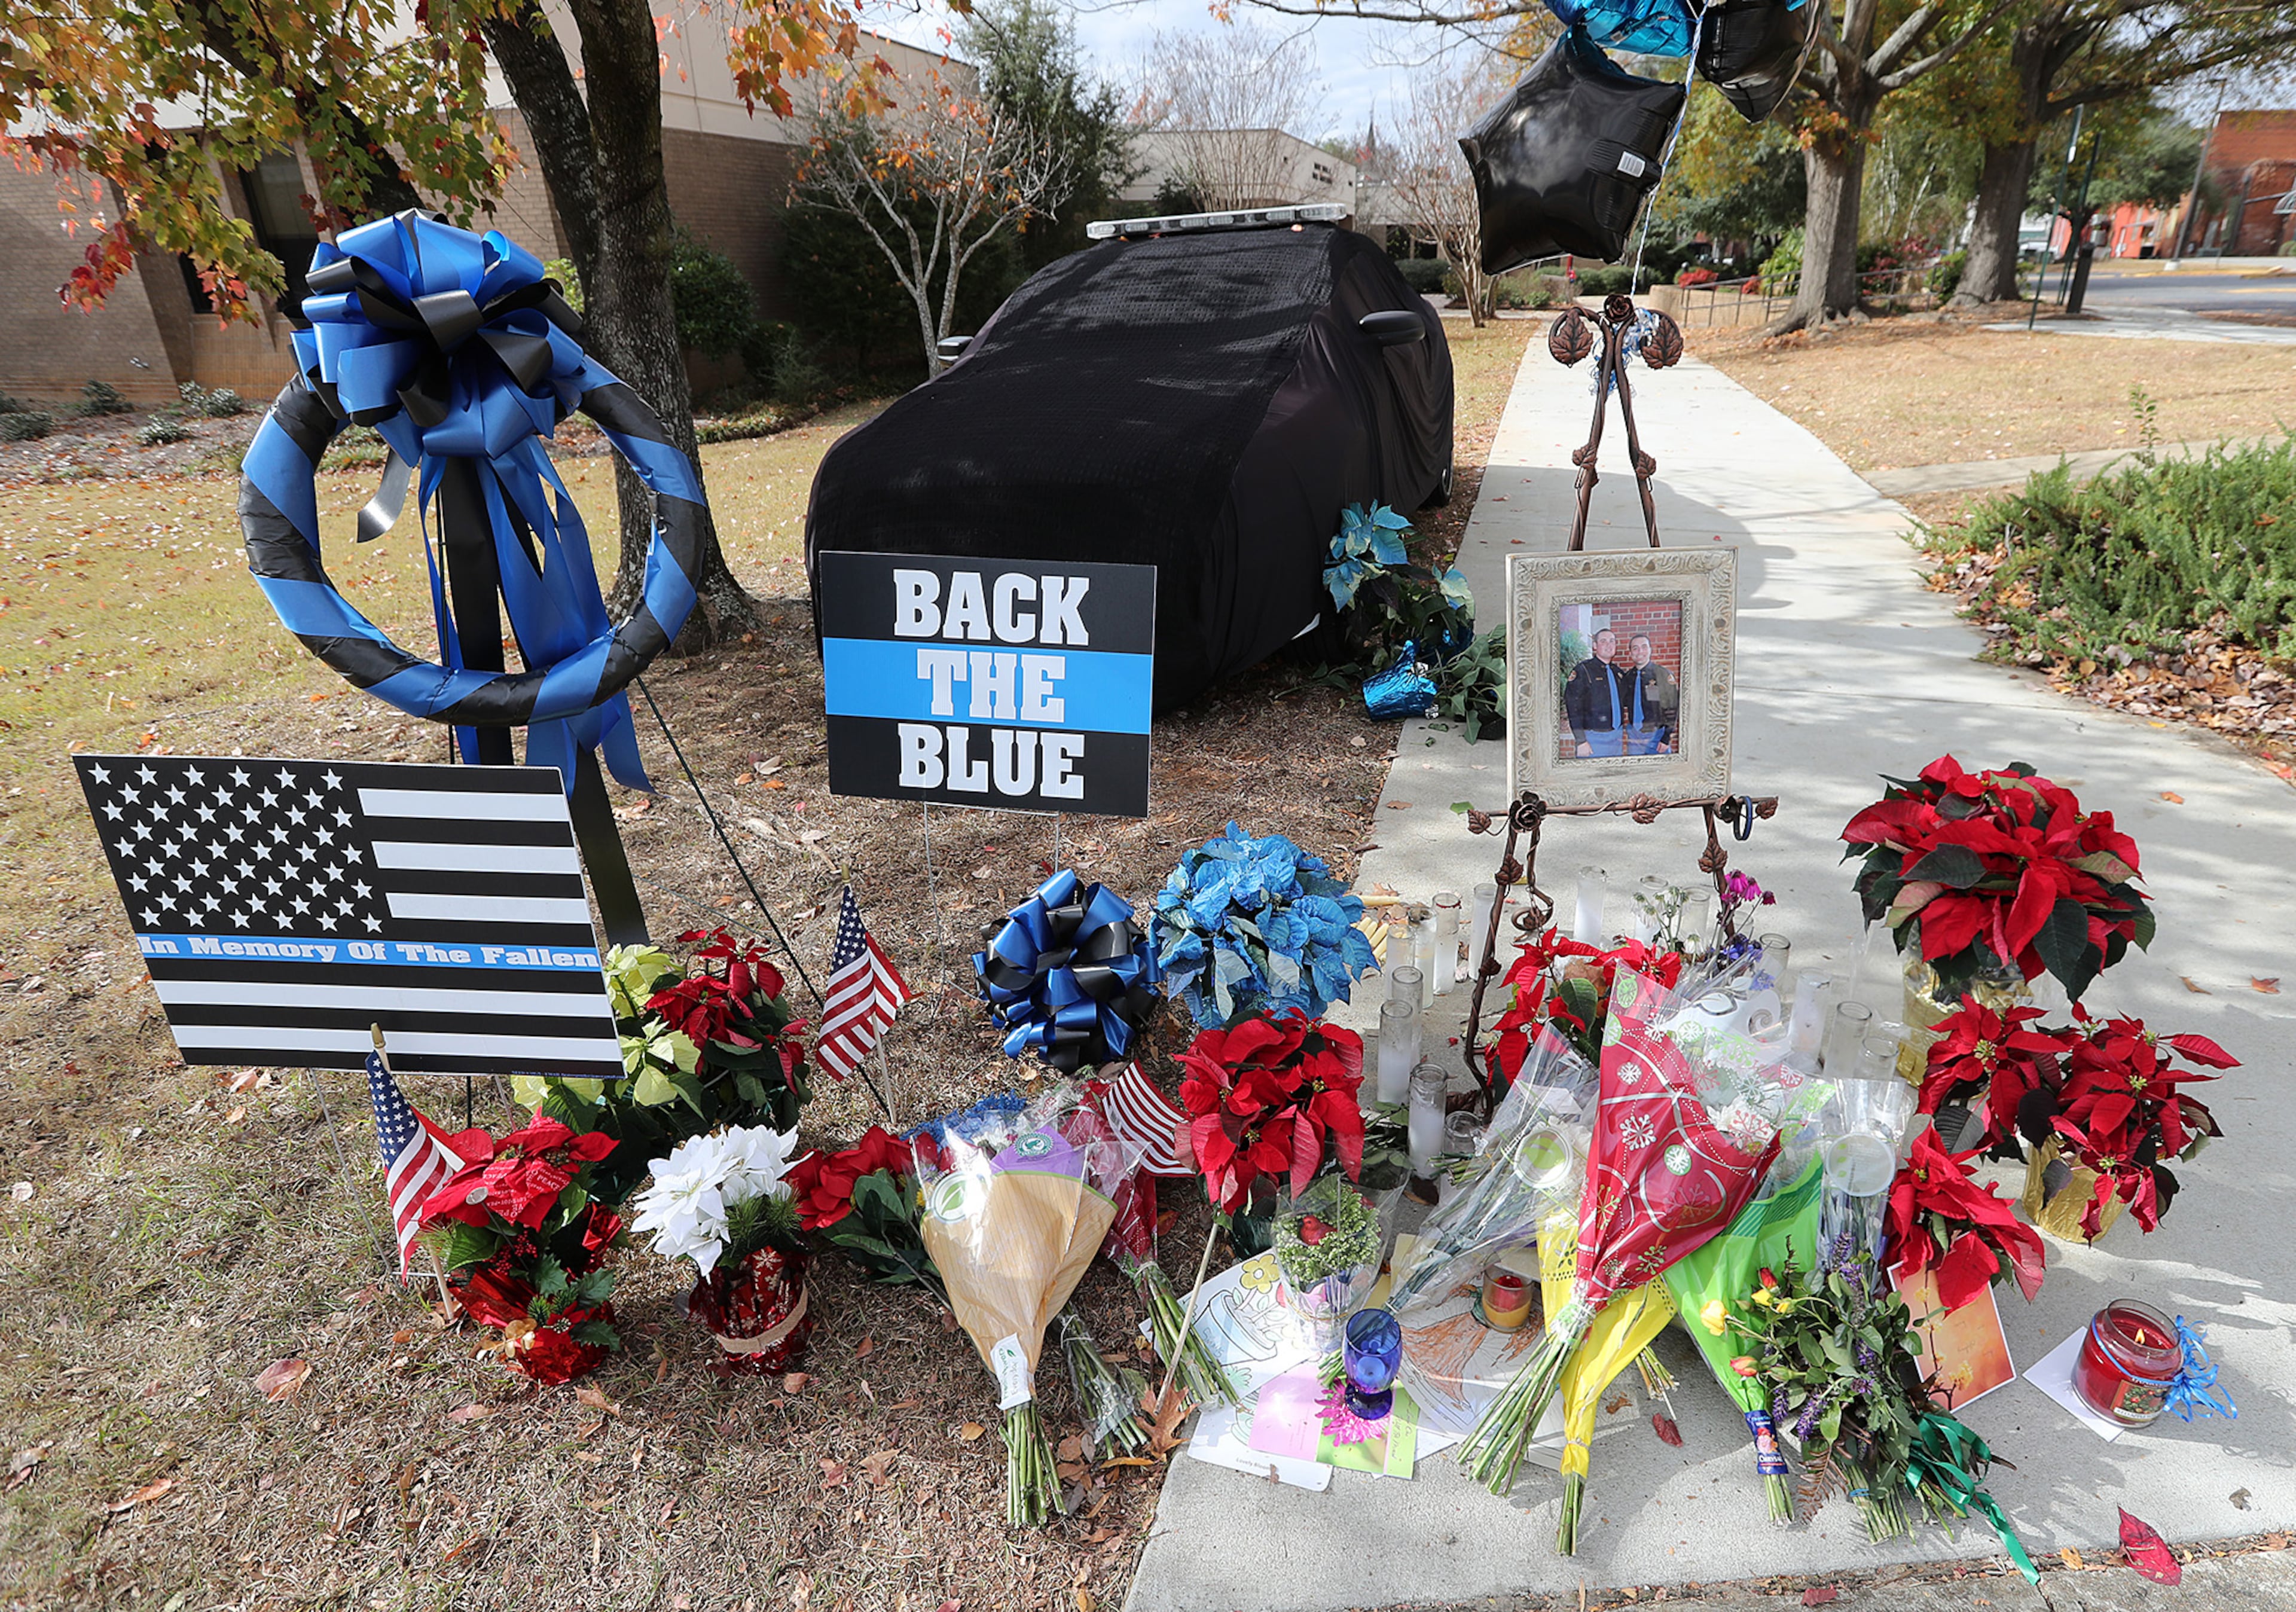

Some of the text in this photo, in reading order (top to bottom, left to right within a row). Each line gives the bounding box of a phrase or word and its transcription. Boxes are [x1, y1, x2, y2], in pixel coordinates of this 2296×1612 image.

[893, 569, 1090, 646] BACK
[917, 648, 1066, 722] THE
[897, 722, 1085, 799] BLUE
[137, 936, 600, 967] In Memory Of The Fallen
